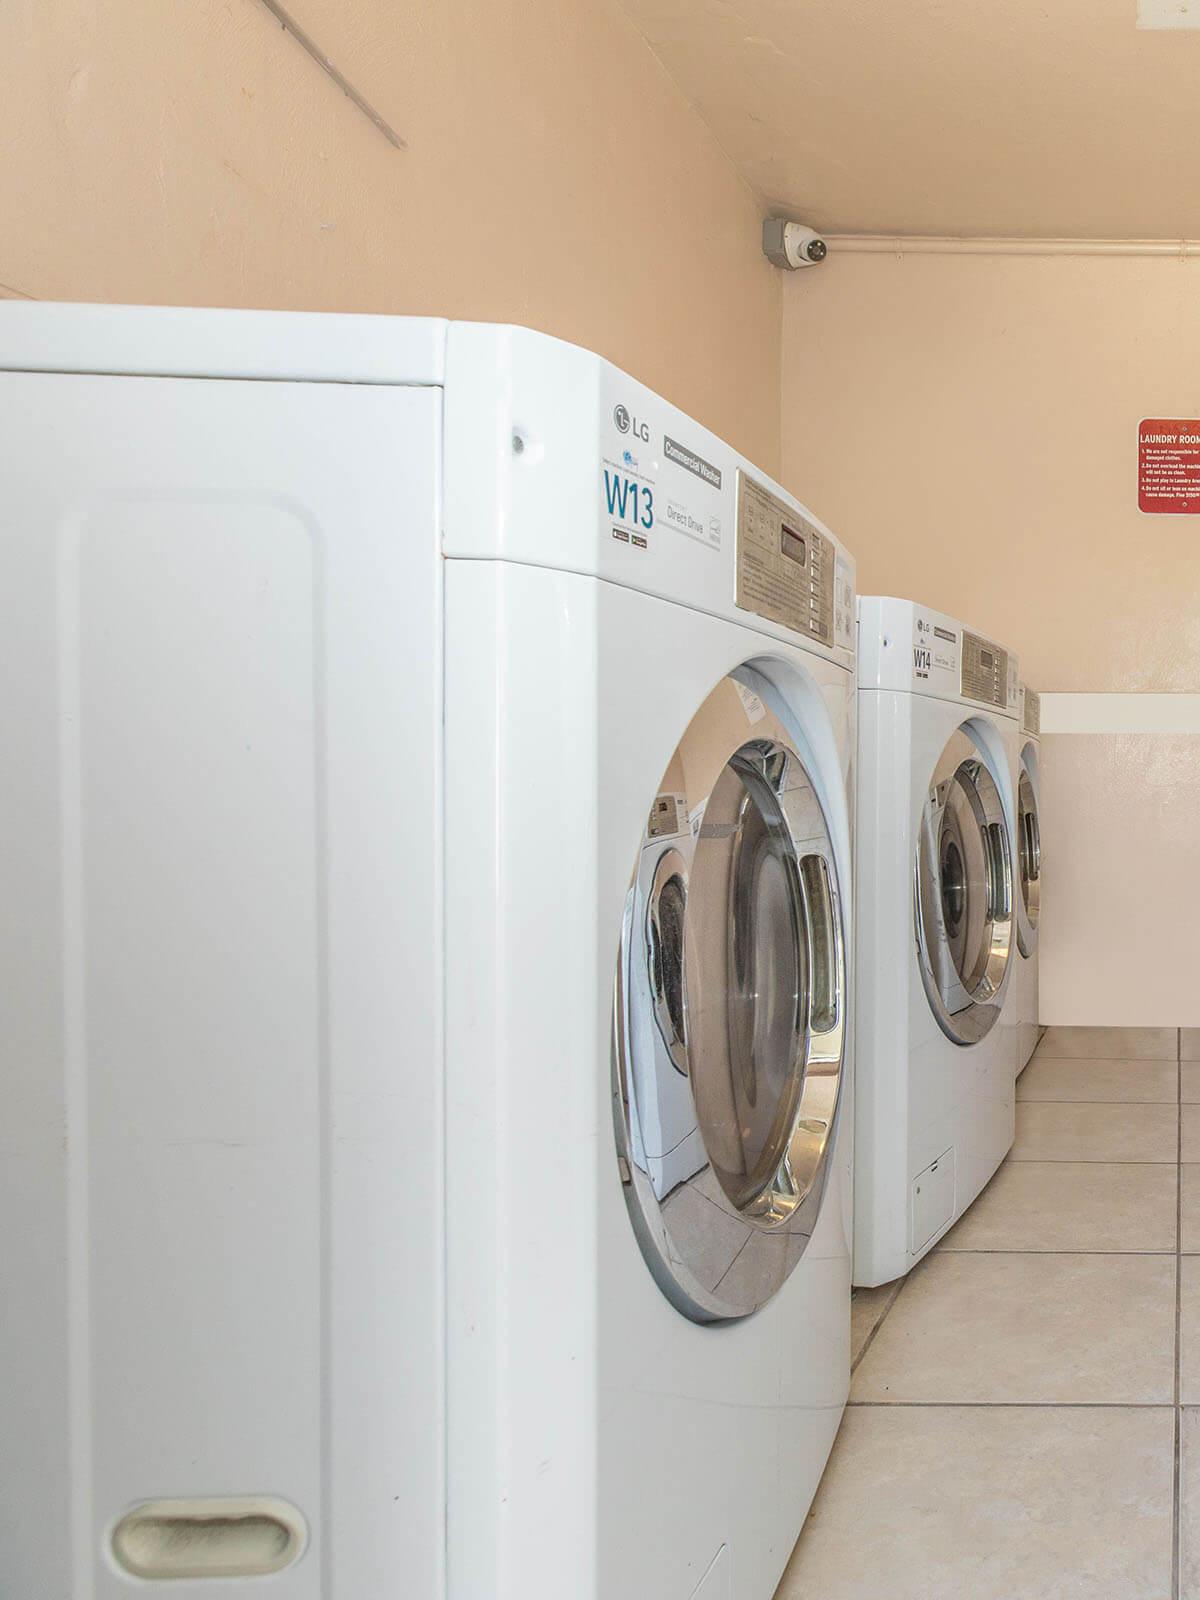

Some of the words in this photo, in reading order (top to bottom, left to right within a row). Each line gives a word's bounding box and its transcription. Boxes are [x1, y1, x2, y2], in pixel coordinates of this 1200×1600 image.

[632, 417, 650, 443] LG
[1140, 435, 1176, 444] LAUNDRY
[666, 441, 700, 472] Commercial
[700, 463, 721, 483] Washer
[604, 470, 653, 528] W13
[667, 505, 688, 527] Direct
[688, 515, 704, 534] Drive
[923, 623, 930, 632] LG
[914, 649, 931, 669] W14
